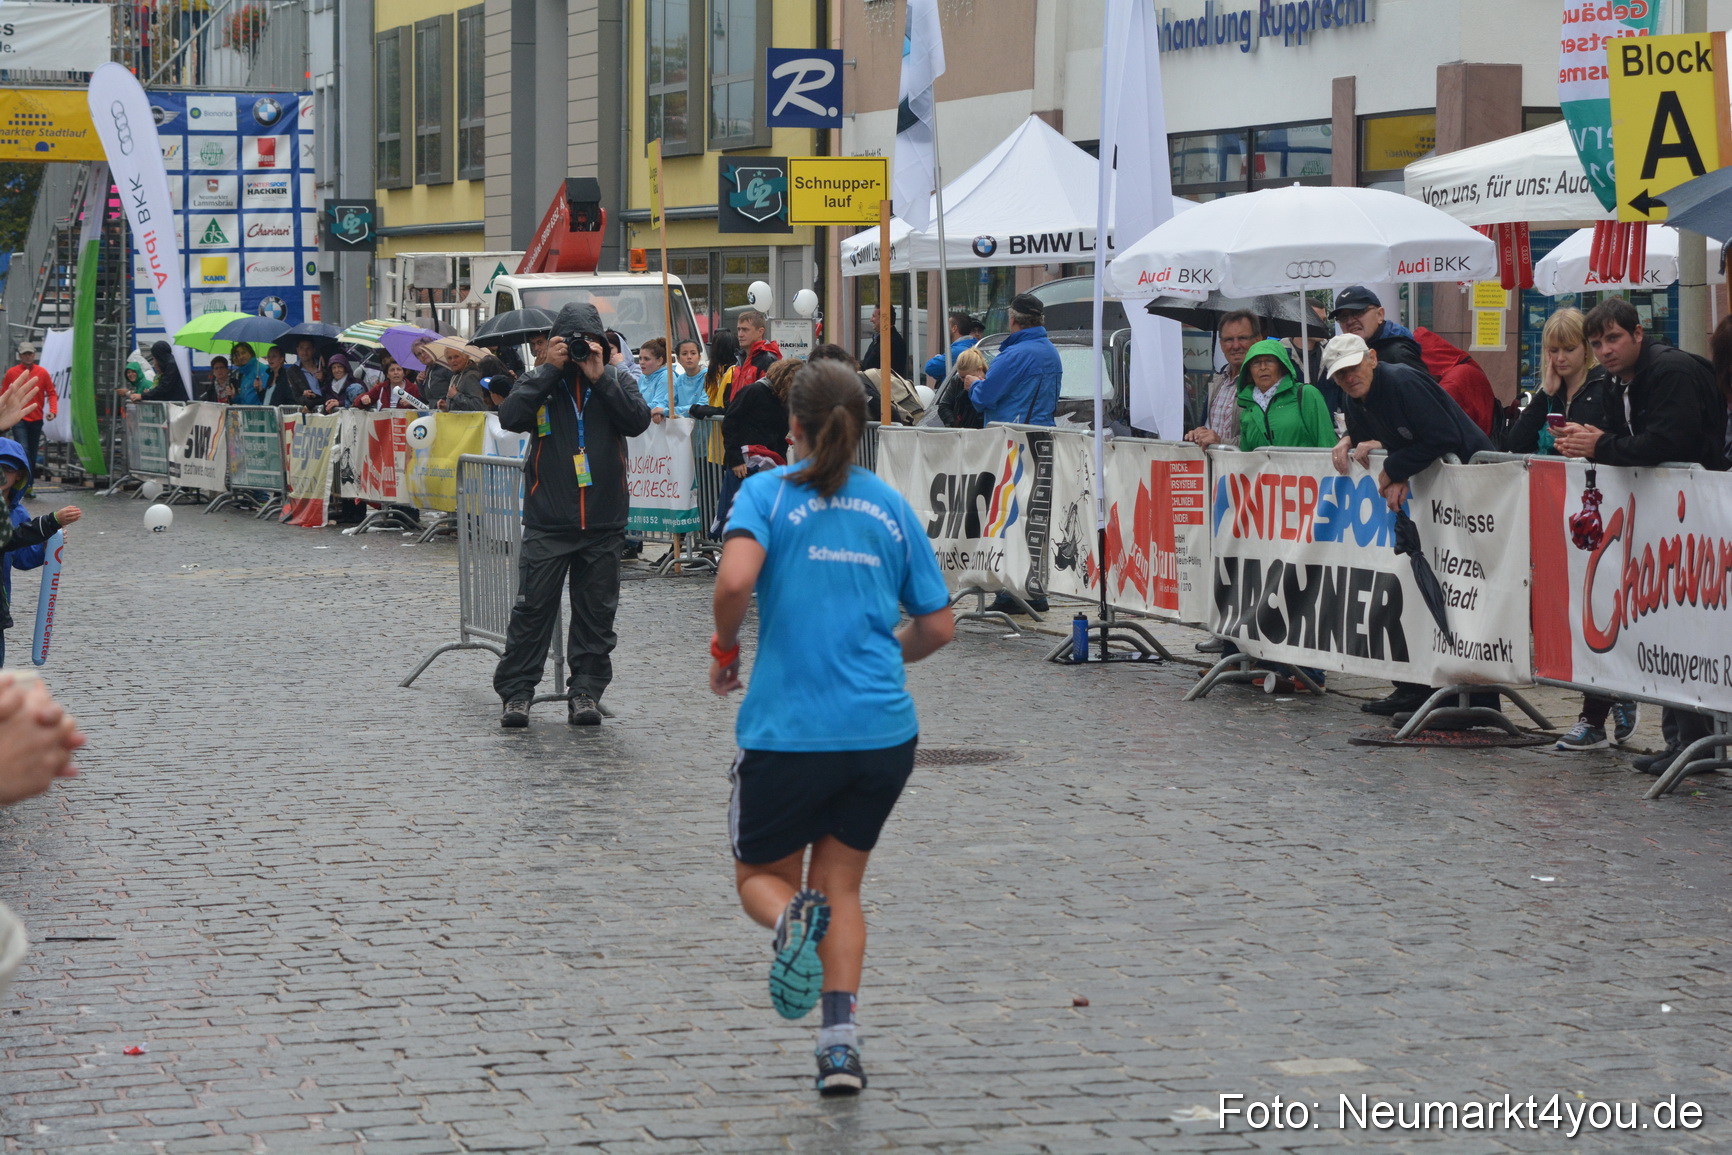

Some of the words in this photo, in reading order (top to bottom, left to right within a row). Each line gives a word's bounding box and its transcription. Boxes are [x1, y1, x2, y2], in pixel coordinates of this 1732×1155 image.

[1621, 41, 1714, 77] Block
[203, 110, 234, 118] Bionorica
[38, 128, 88, 138] Stadtlauf
[1640, 90, 1707, 180] A
[247, 187, 288, 195] HACKNER
[794, 176, 881, 192] Schnupper-
[1451, 183, 1481, 205] uns,
[1486, 174, 1512, 199] für
[1515, 176, 1551, 197] uns:
[823, 194, 852, 208] lauf
[246, 223, 292, 239] Charivari
[1009, 232, 1073, 255] BMW
[270, 265, 286, 273] BKK
[1138, 267, 1172, 285] Audi
[1178, 268, 1214, 284] BKK
[1397, 257, 1431, 276] Audi
[1434, 256, 1471, 272] BKK
[203, 274, 226, 282] KANN
[788, 504, 808, 525] SV
[830, 496, 904, 543] AUERBACH
[808, 545, 882, 568] Schwimmen
[50, 572, 61, 590] TUI
[1441, 581, 1478, 611] Stadt
[1214, 556, 1410, 663] HACKNER
[40, 593, 57, 660] ReiseCenter
[1449, 630, 1513, 663] Neumarkt
[1637, 641, 1719, 685] Ostbayerns
